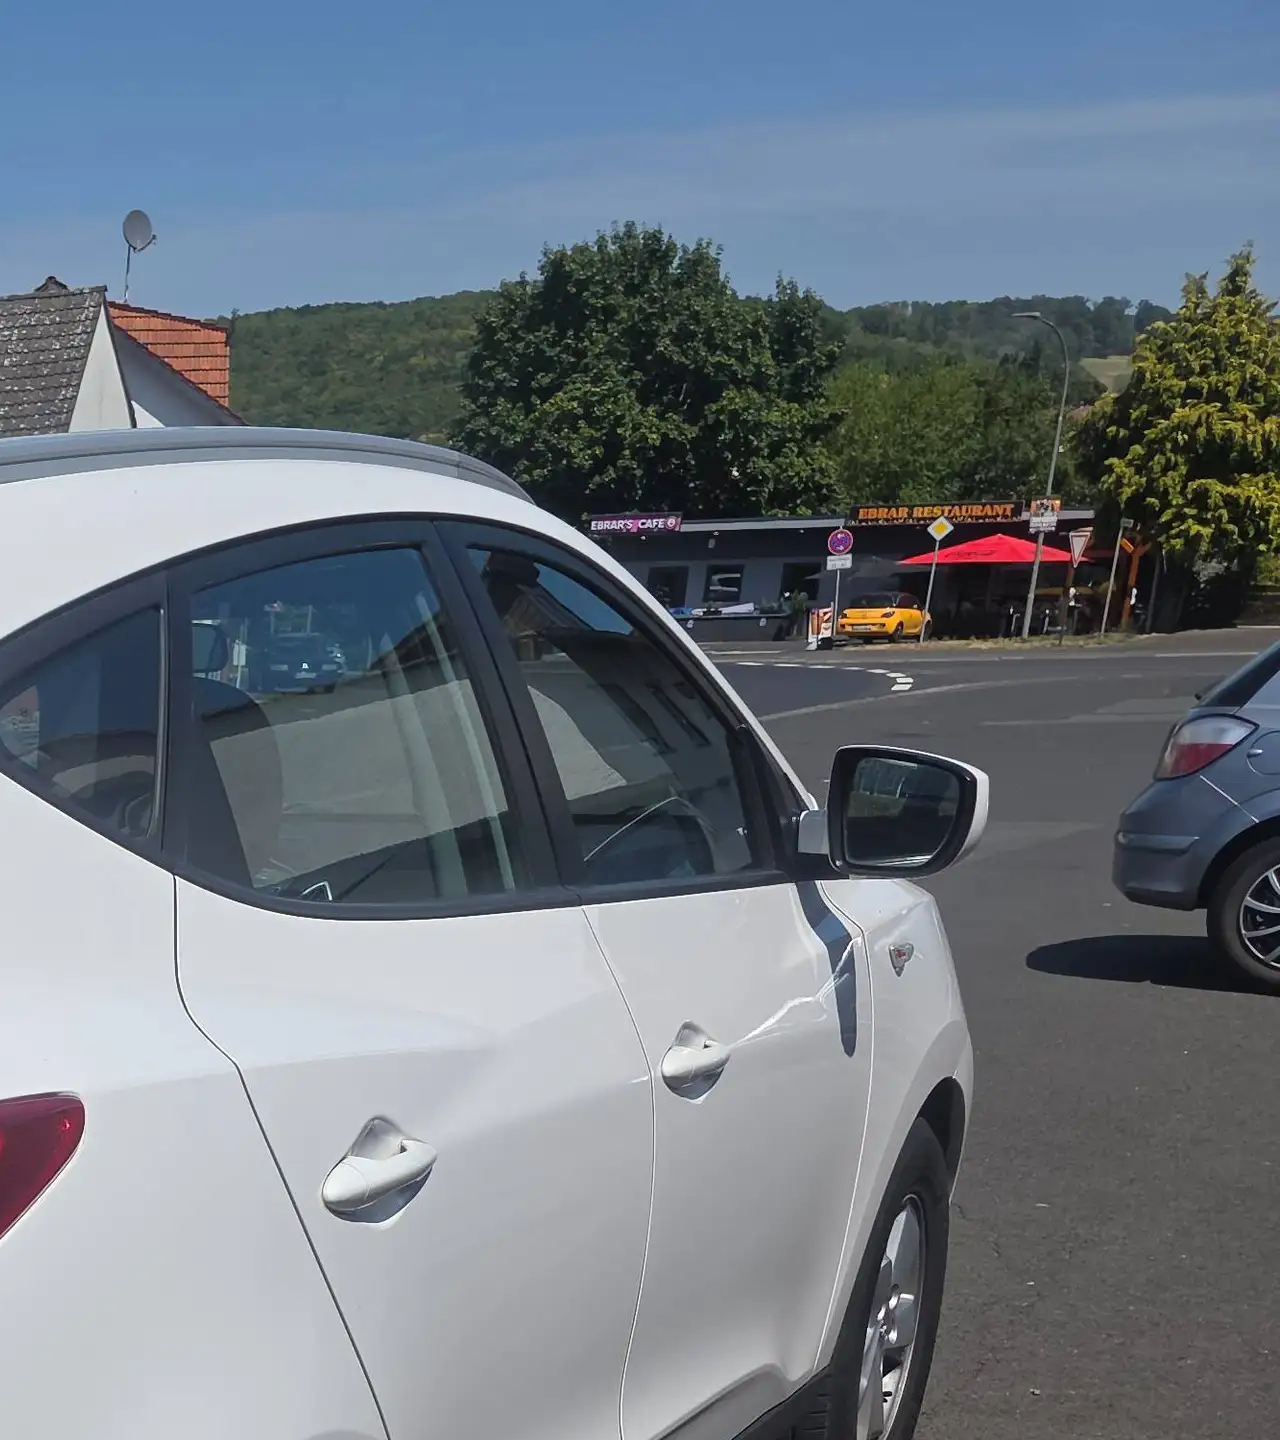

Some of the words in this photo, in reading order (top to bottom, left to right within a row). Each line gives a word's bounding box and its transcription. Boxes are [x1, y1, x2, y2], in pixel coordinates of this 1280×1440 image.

[859, 503, 908, 520] EBRAR
[912, 503, 1014, 518] RESTAURANT
[590, 519, 633, 531] EBRAR'S
